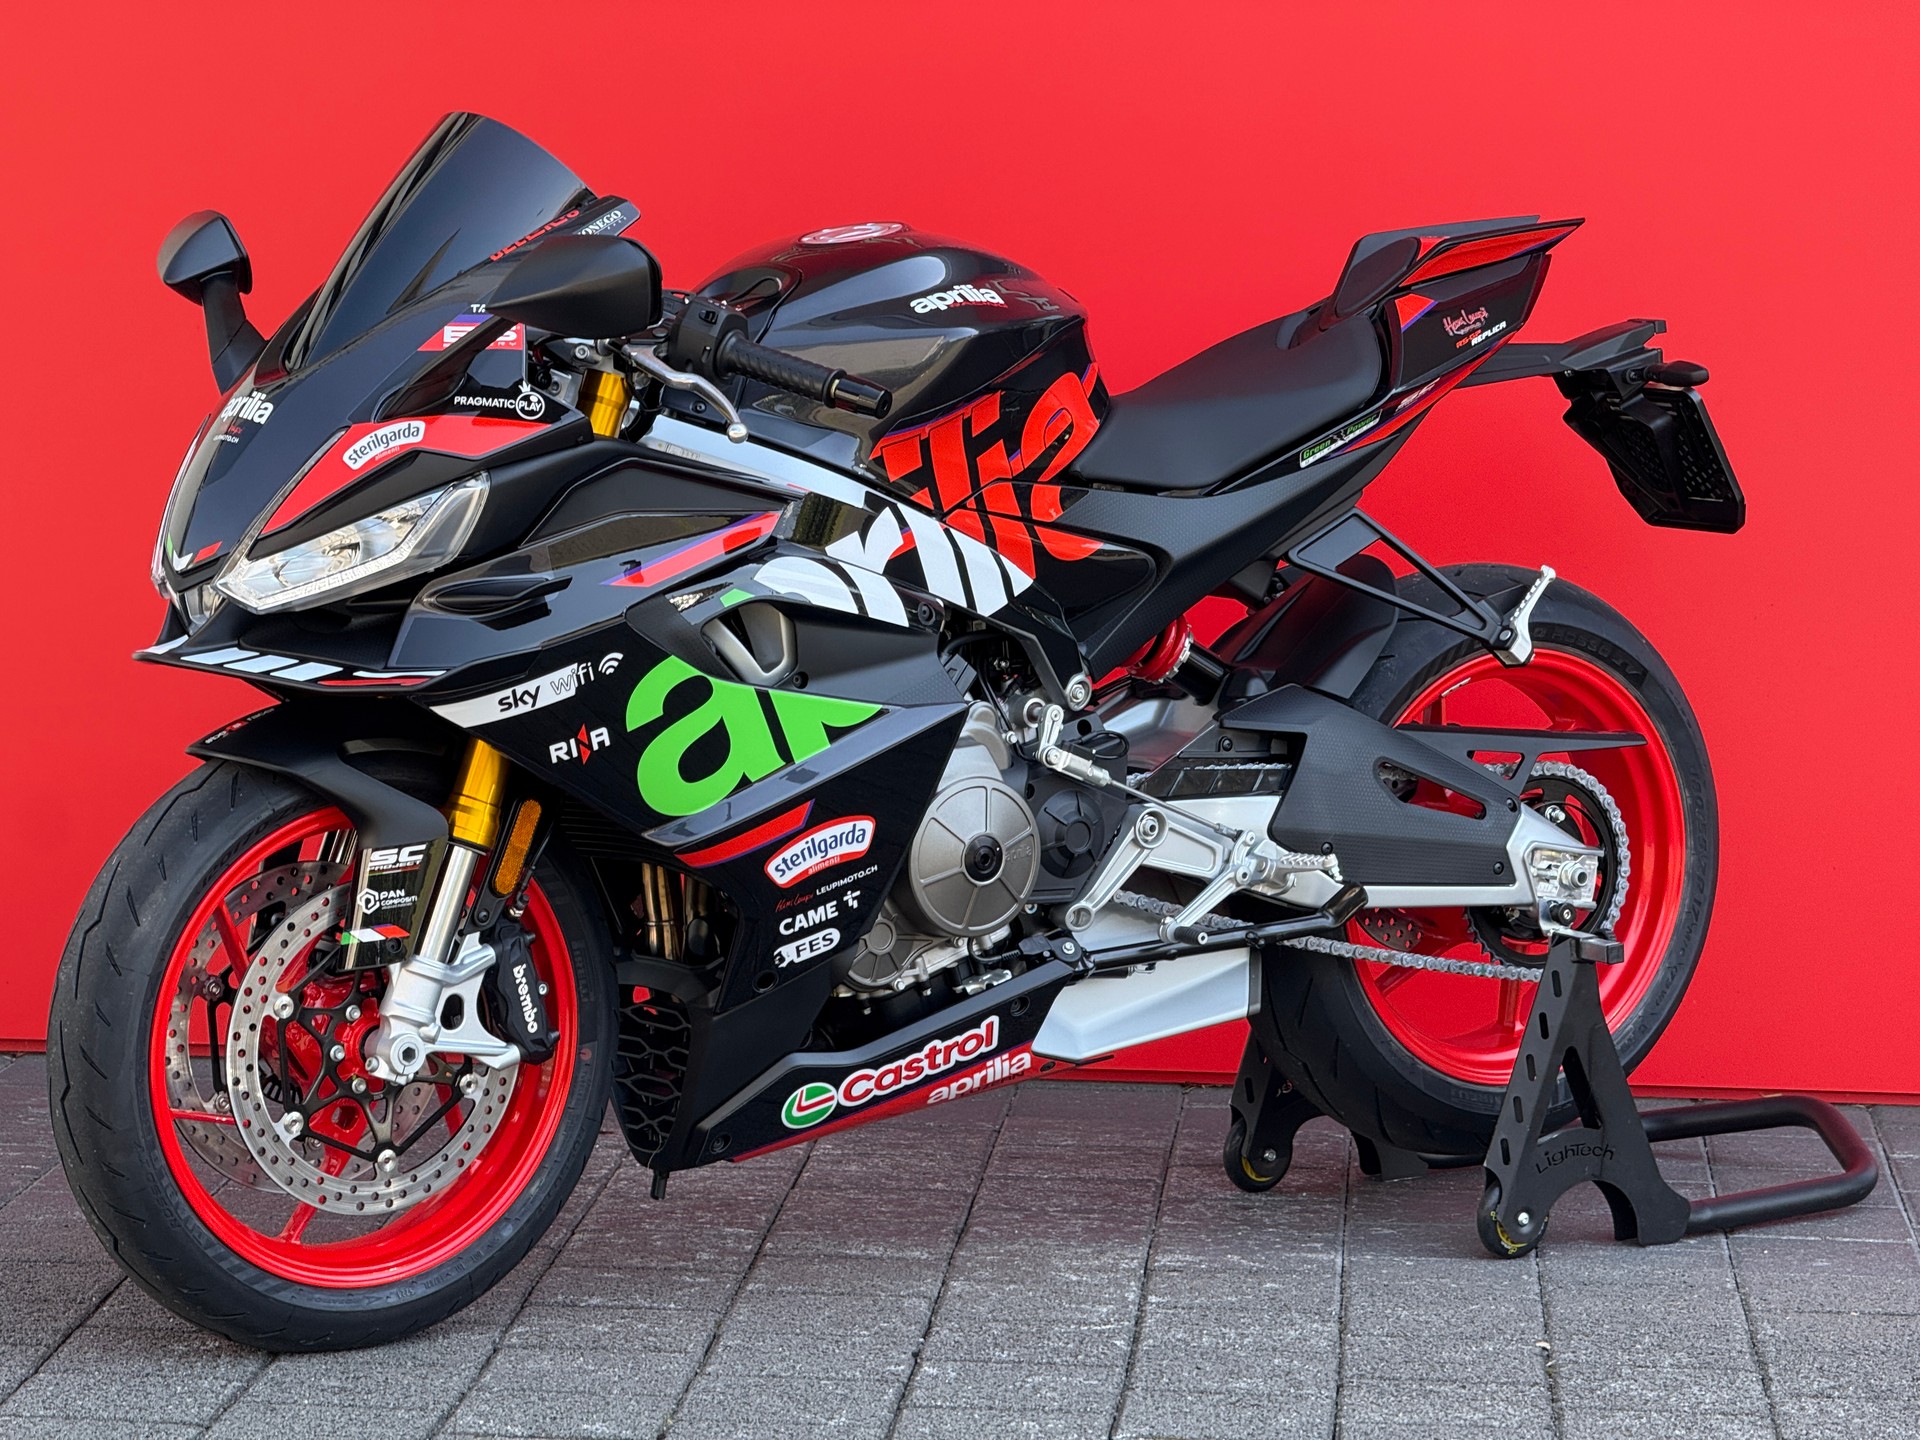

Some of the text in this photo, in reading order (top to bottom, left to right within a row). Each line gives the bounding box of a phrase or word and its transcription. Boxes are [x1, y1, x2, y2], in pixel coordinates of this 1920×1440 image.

[577, 210, 622, 236] ONEGO
[910, 284, 1005, 314] aprilia
[1471, 320, 1507, 347] REPLICA
[221, 391, 274, 425] aprilia
[454, 396, 542, 412] PRAGMATIC PLAY
[347, 422, 420, 465] sterilgarda
[1302, 440, 1332, 460] Green
[1346, 414, 1378, 435] Power
[374, 445, 400, 462] alimenti
[497, 661, 595, 713] sky wifi
[548, 722, 611, 766] RINA
[368, 843, 428, 868] SC
[774, 823, 867, 878] sterilgarda
[807, 855, 841, 875] alimenti
[380, 888, 406, 900] PAN
[816, 864, 878, 896] LEUPIMOTO.CH
[381, 895, 418, 907] COMPOSITI
[779, 900, 839, 936] CAME
[795, 931, 835, 959] FES
[512, 963, 538, 1034] brembo
[840, 1018, 997, 1104] Castrol
[925, 1051, 1033, 1105] aprilia
